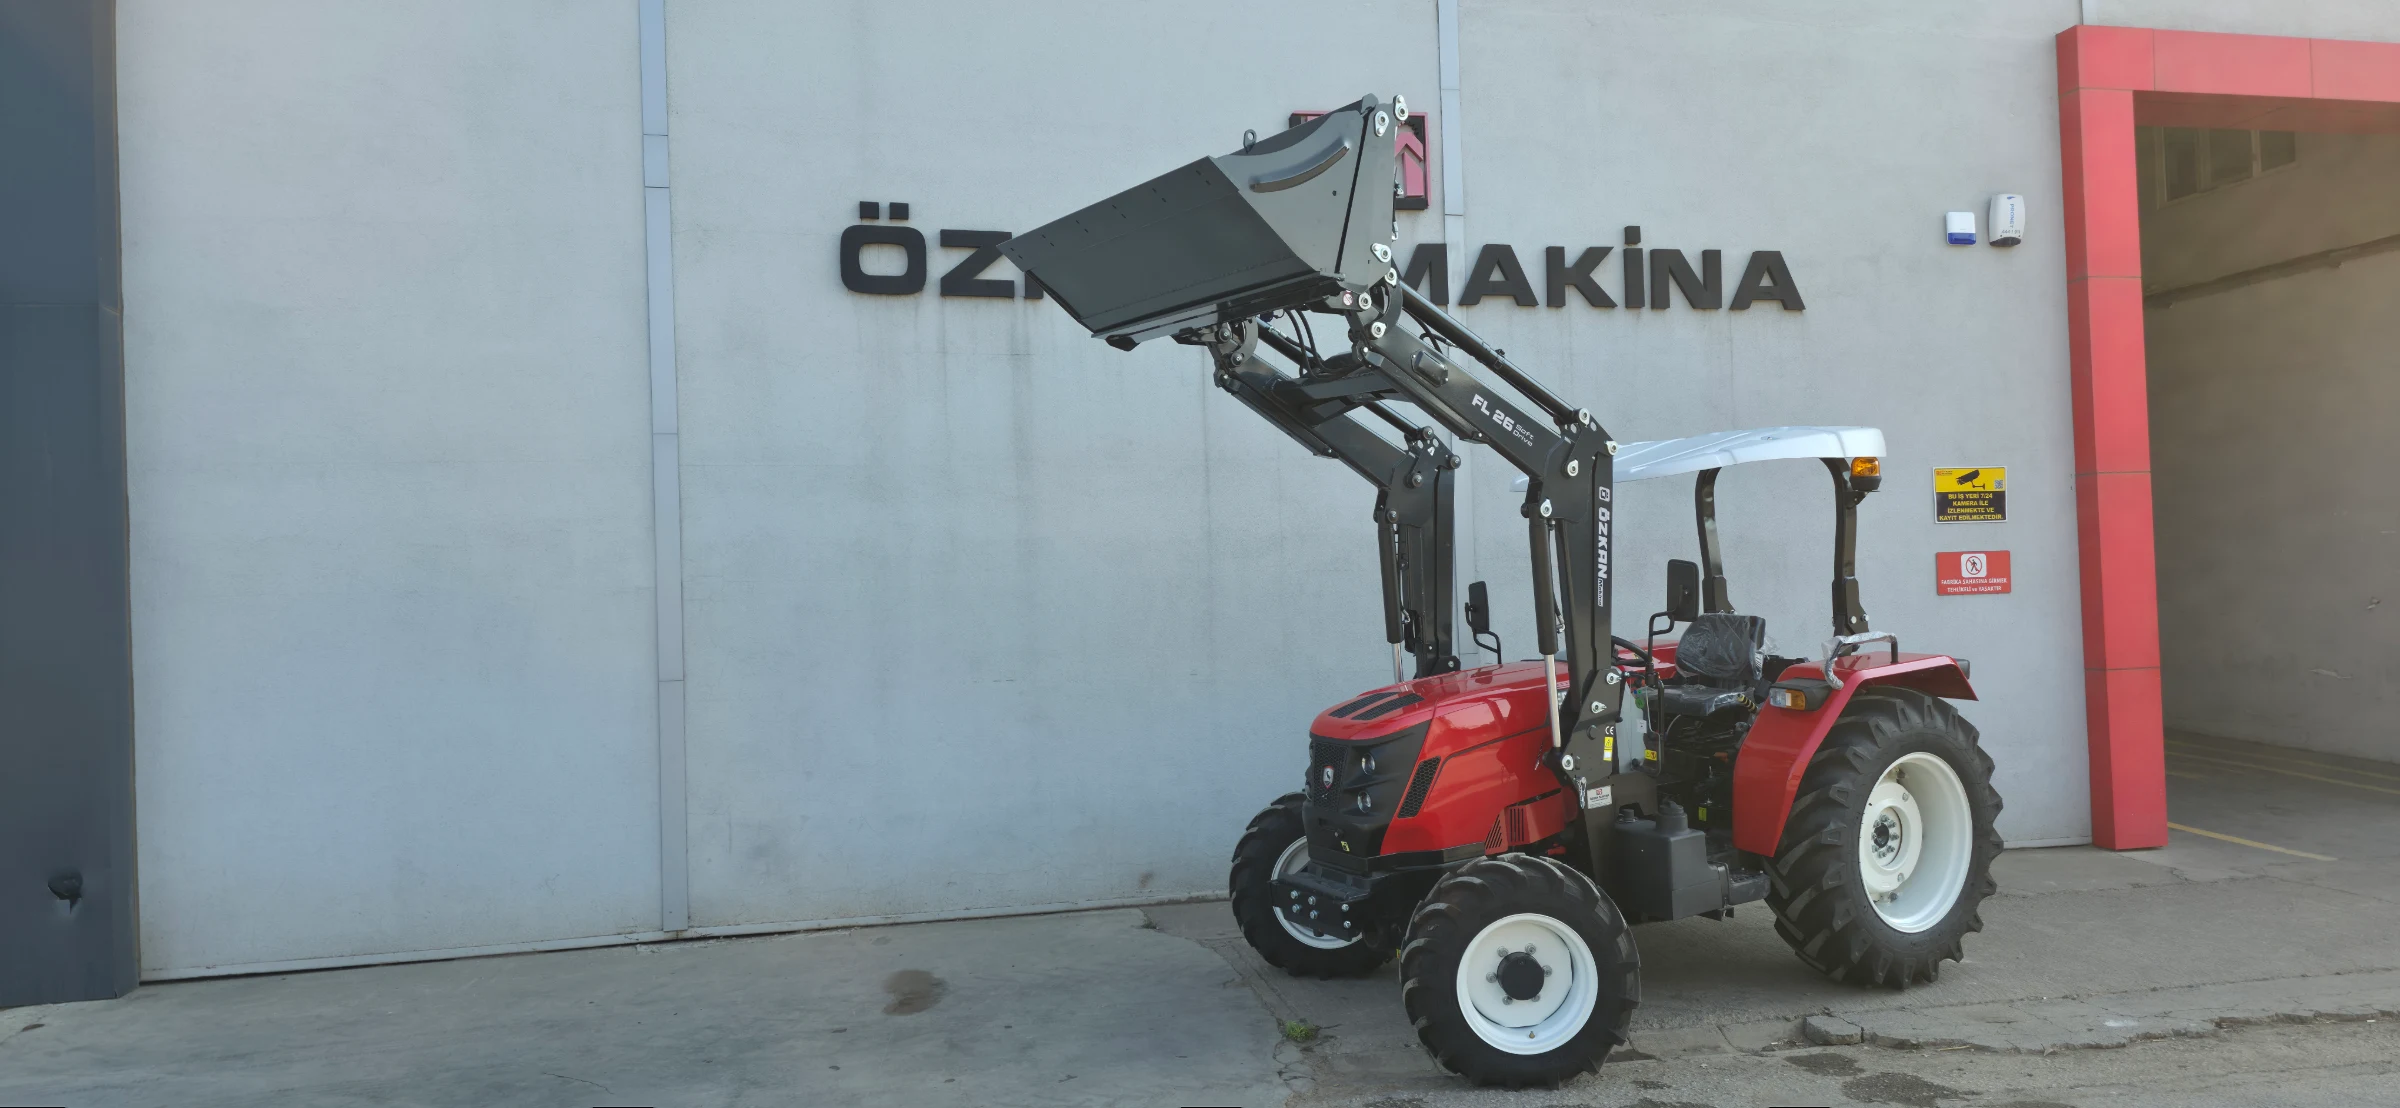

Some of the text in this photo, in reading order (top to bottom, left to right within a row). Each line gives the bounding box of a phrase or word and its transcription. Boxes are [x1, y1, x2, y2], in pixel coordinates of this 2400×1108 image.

[840, 201, 1044, 299] ÖZ
[1472, 394, 1515, 432] FL 26
[1515, 424, 1534, 440] Soft
[1512, 429, 1533, 447] Drive
[1598, 507, 1610, 579] ÖZKAN
